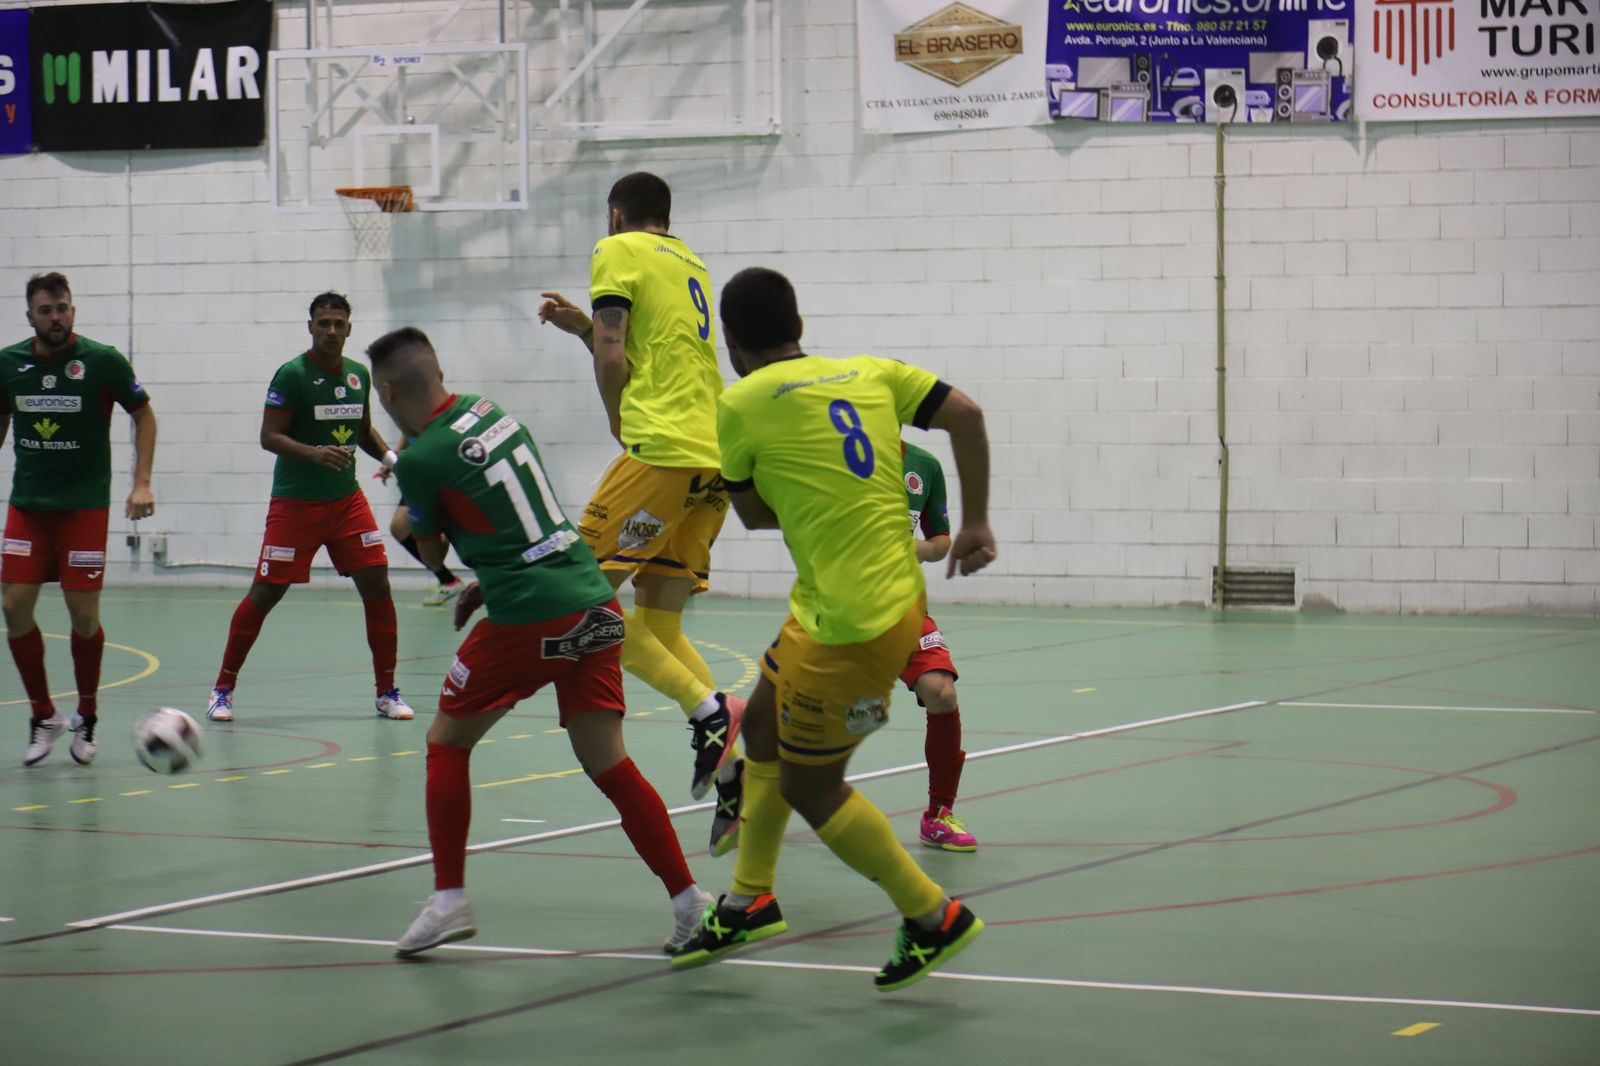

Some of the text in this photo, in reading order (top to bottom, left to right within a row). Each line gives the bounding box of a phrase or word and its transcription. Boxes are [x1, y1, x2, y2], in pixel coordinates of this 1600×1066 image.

[1481, 0, 1600, 18] MAR
[1066, 21, 1156, 32] www.euronics.es
[1236, 20, 1249, 31] 21
[898, 32, 1018, 55] EL BRASERO
[1064, 34, 1267, 47] Avda. Portugal, 2 (Junto a La Valenciana)
[1478, 23, 1594, 57] TURI
[92, 46, 260, 103] MILAR
[1373, 86, 1600, 109] CONSULTORÍA & FORM
[687, 276, 710, 341] 9
[25, 398, 78, 408] euronics
[43, 441, 80, 450] RURAL
[828, 398, 875, 480] 8
[483, 442, 566, 544] 11
[260, 562, 269, 576] 8
[558, 623, 624, 652] EL BRSERO
